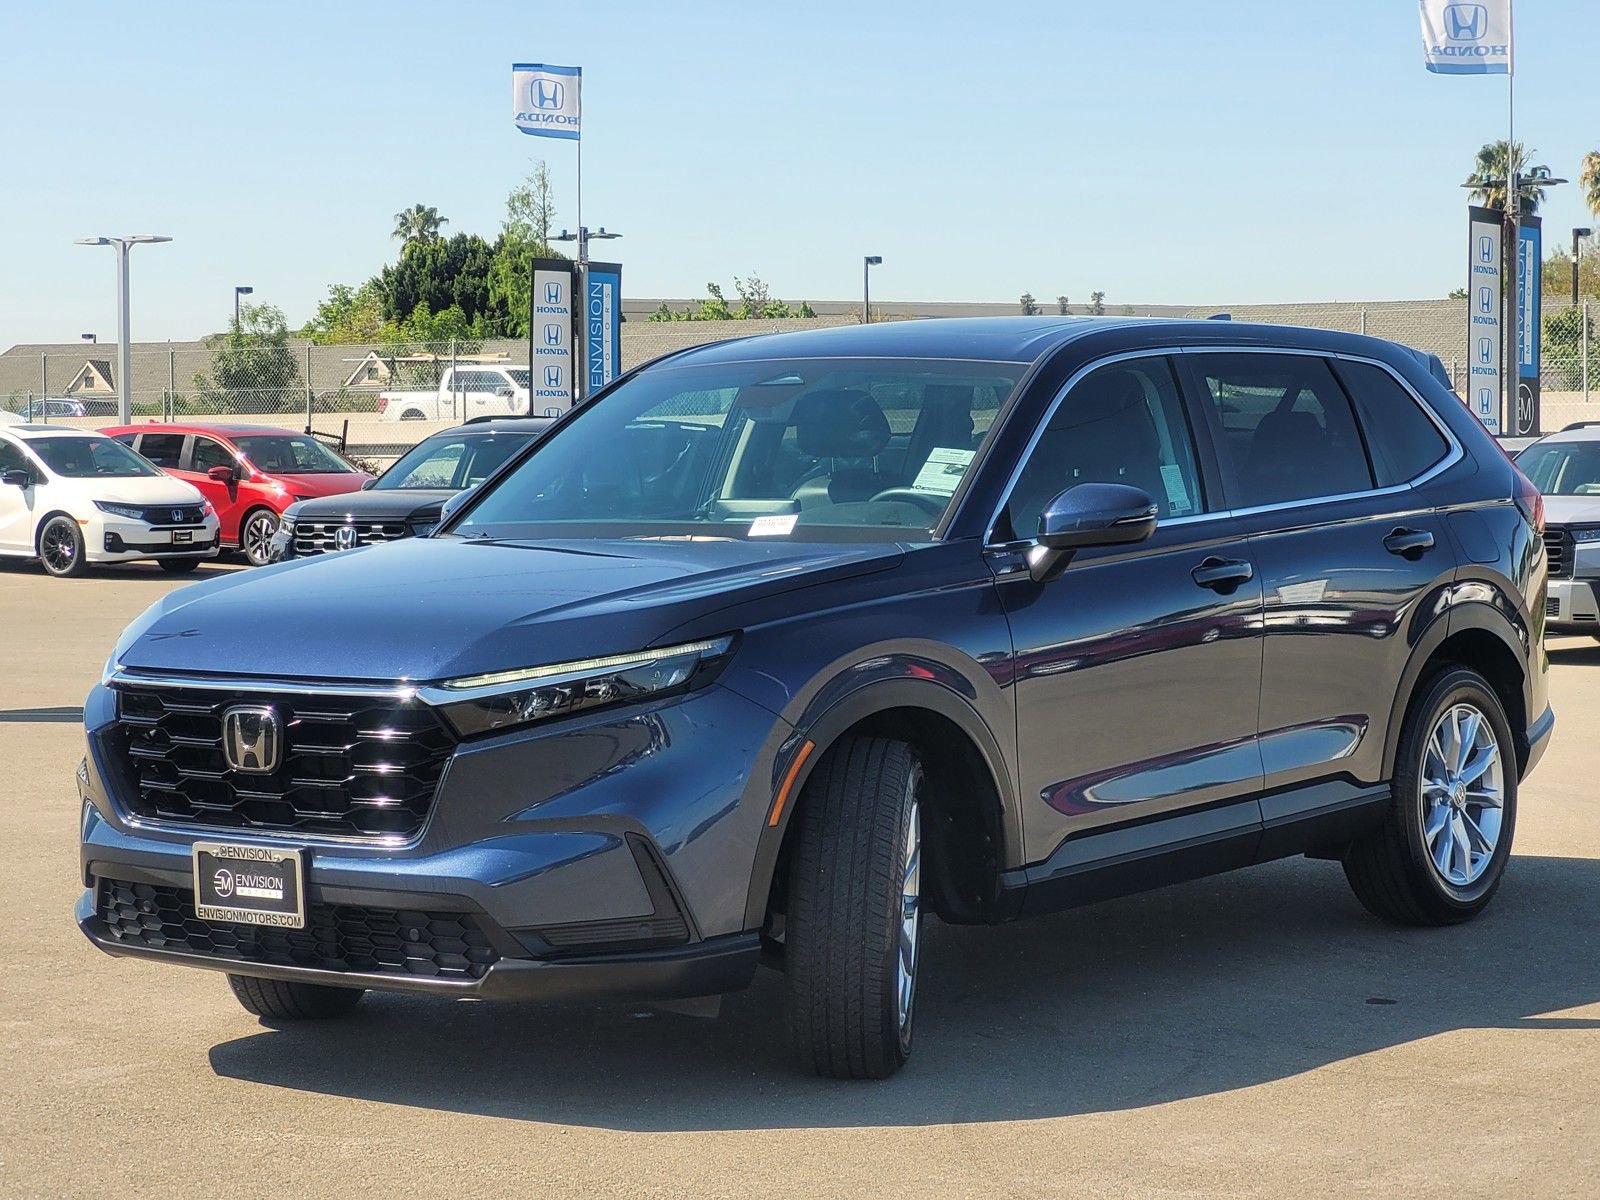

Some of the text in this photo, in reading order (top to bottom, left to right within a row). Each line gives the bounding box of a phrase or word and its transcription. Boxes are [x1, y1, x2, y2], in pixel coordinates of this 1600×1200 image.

[1473, 265, 1498, 275] HONDA
[536, 306, 569, 314] HONDA
[1473, 316, 1498, 325] HONDA
[591, 282, 602, 387] ENVISION
[1472, 366, 1498, 375] HONDA
[227, 846, 272, 860] ENVISION
[235, 873, 284, 890] ENVISION
[197, 907, 302, 927] ENVISIONMOTORS.COM
